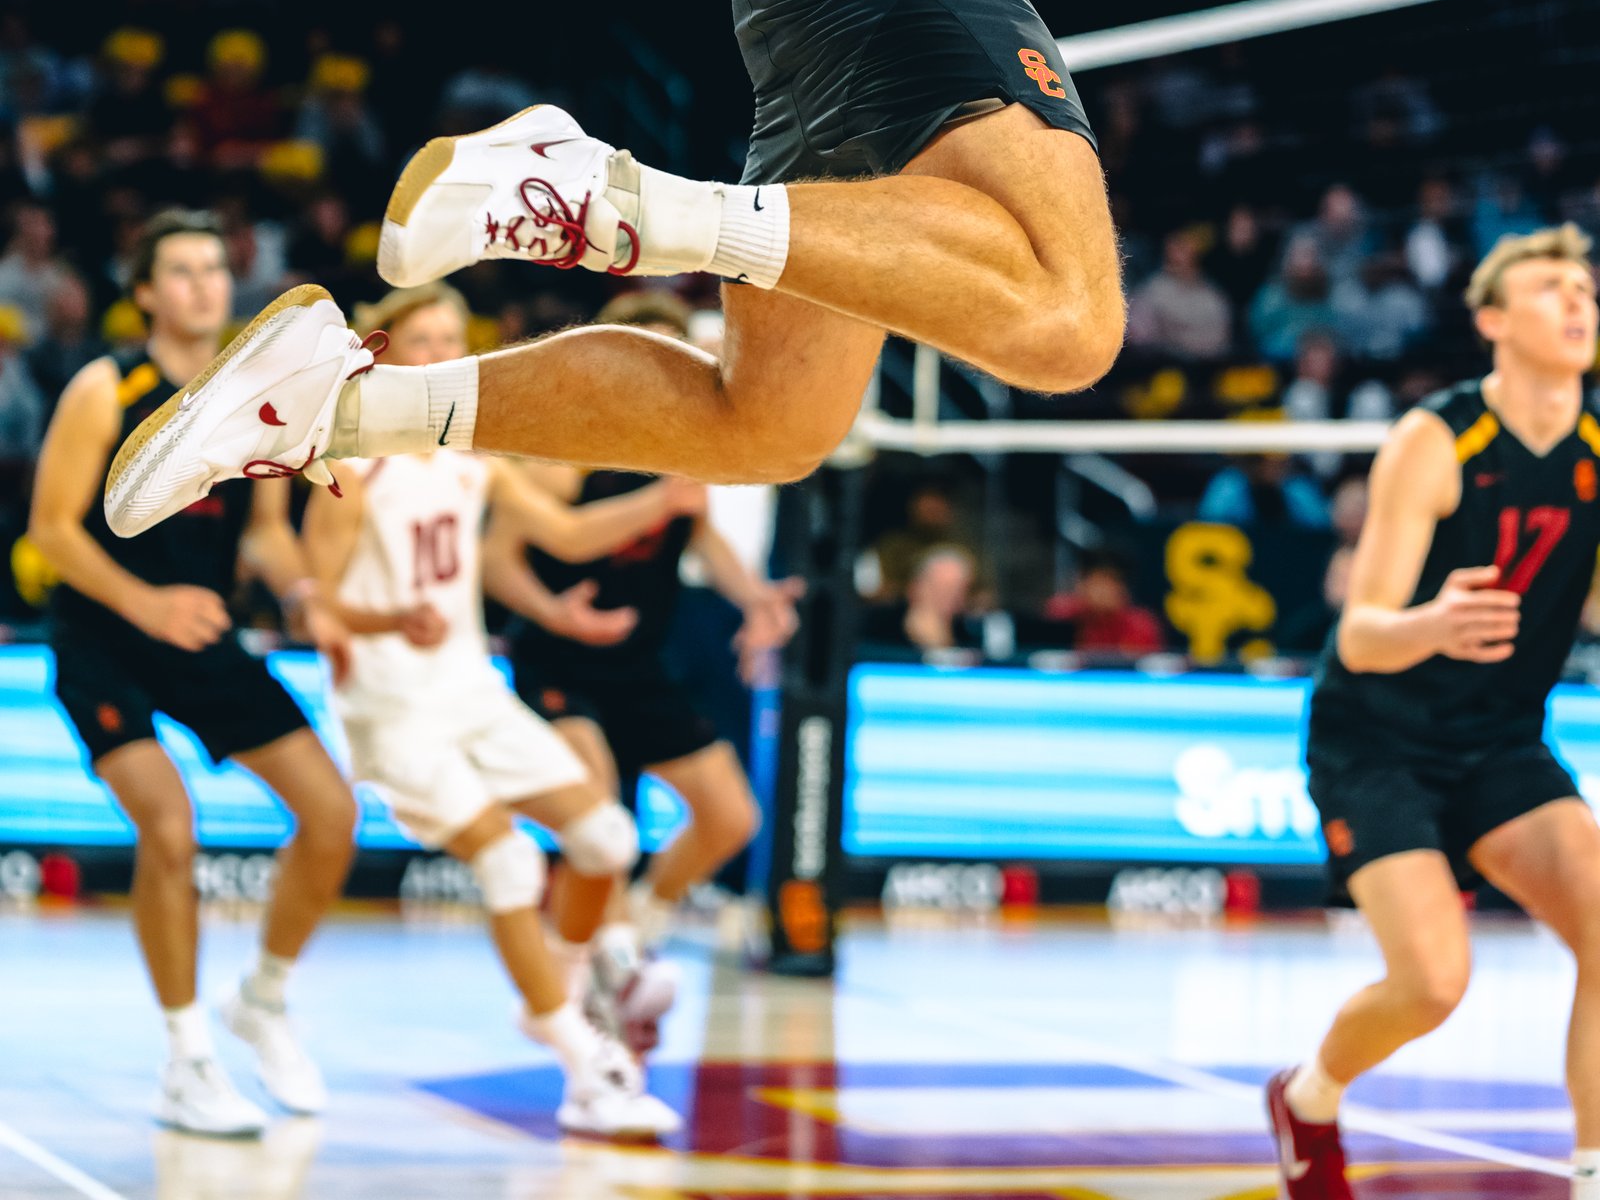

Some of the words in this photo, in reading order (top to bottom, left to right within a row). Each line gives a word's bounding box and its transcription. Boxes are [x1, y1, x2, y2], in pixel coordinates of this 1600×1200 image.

[1018, 48, 1066, 99] SC
[411, 513, 459, 590] 10
[1494, 505, 1571, 596] 17
[1174, 743, 1318, 838] Sm
